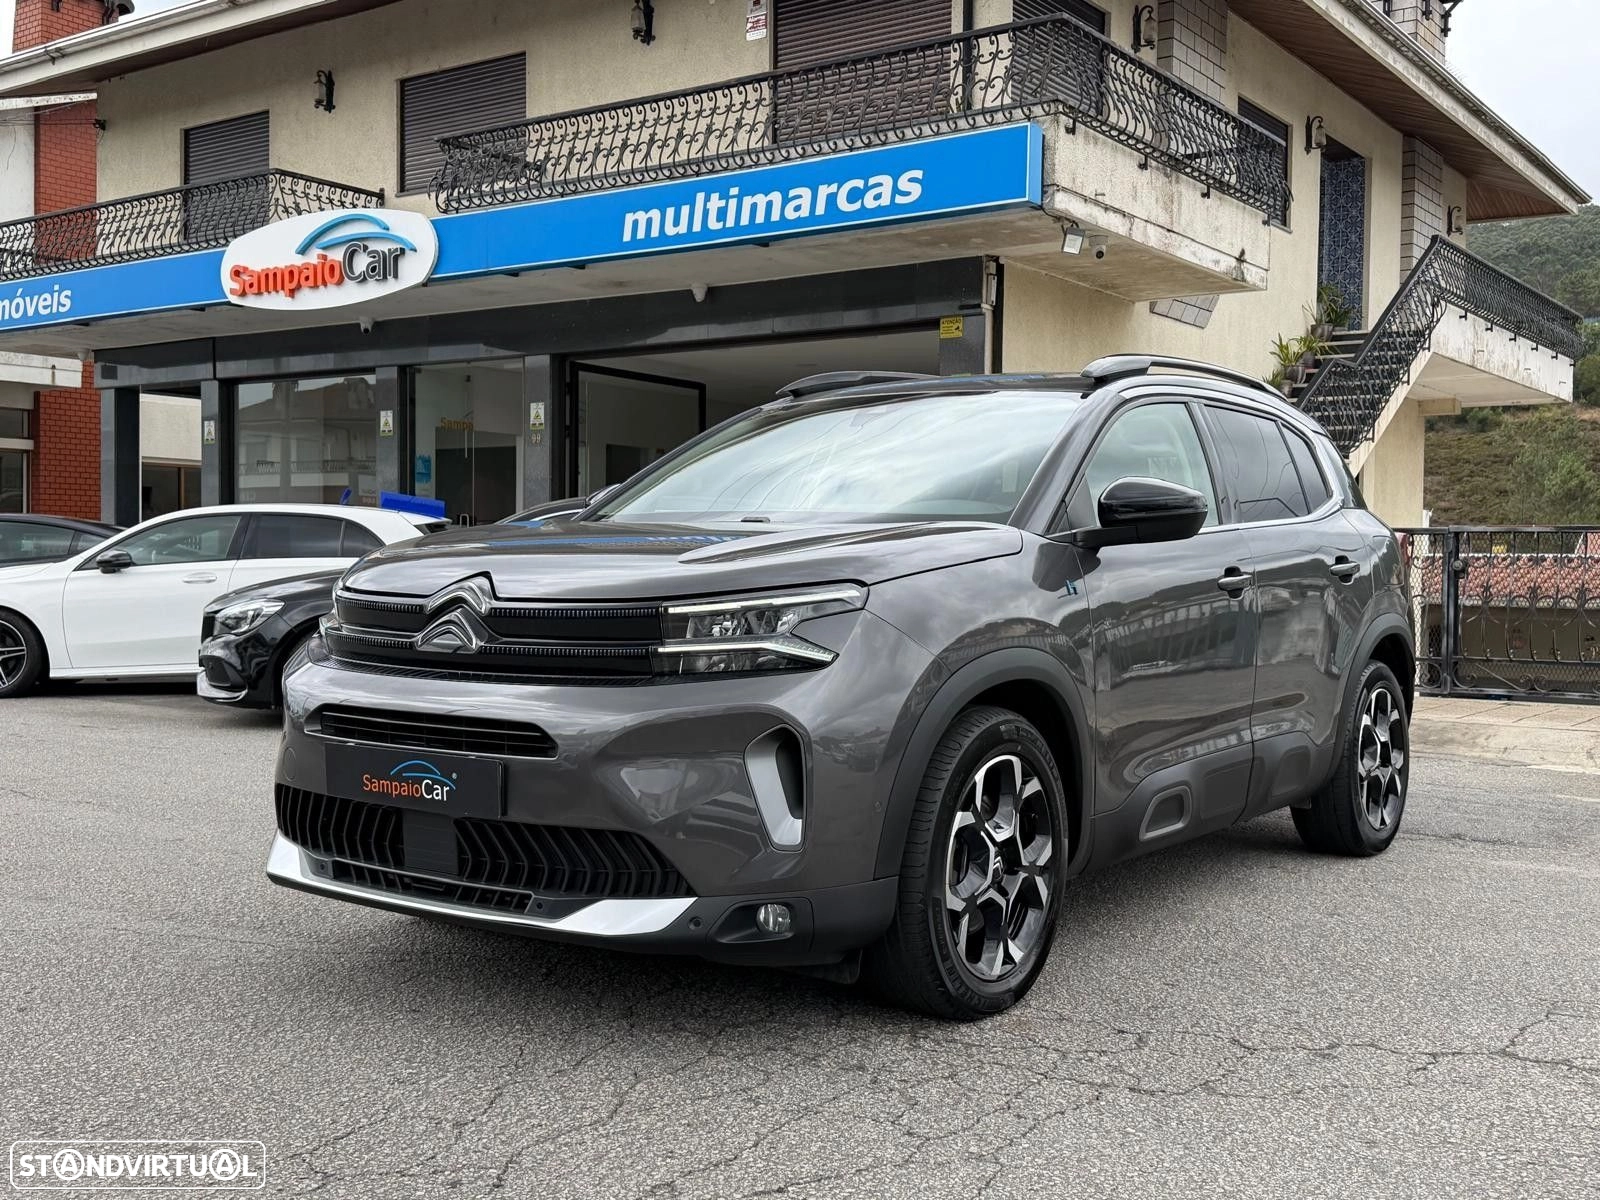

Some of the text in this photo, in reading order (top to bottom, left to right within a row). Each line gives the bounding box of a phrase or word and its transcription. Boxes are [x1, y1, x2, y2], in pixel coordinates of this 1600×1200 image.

[622, 169, 923, 242] multimarcas
[229, 242, 405, 299] SampaioCar
[363, 774, 450, 801] SampaioCar
